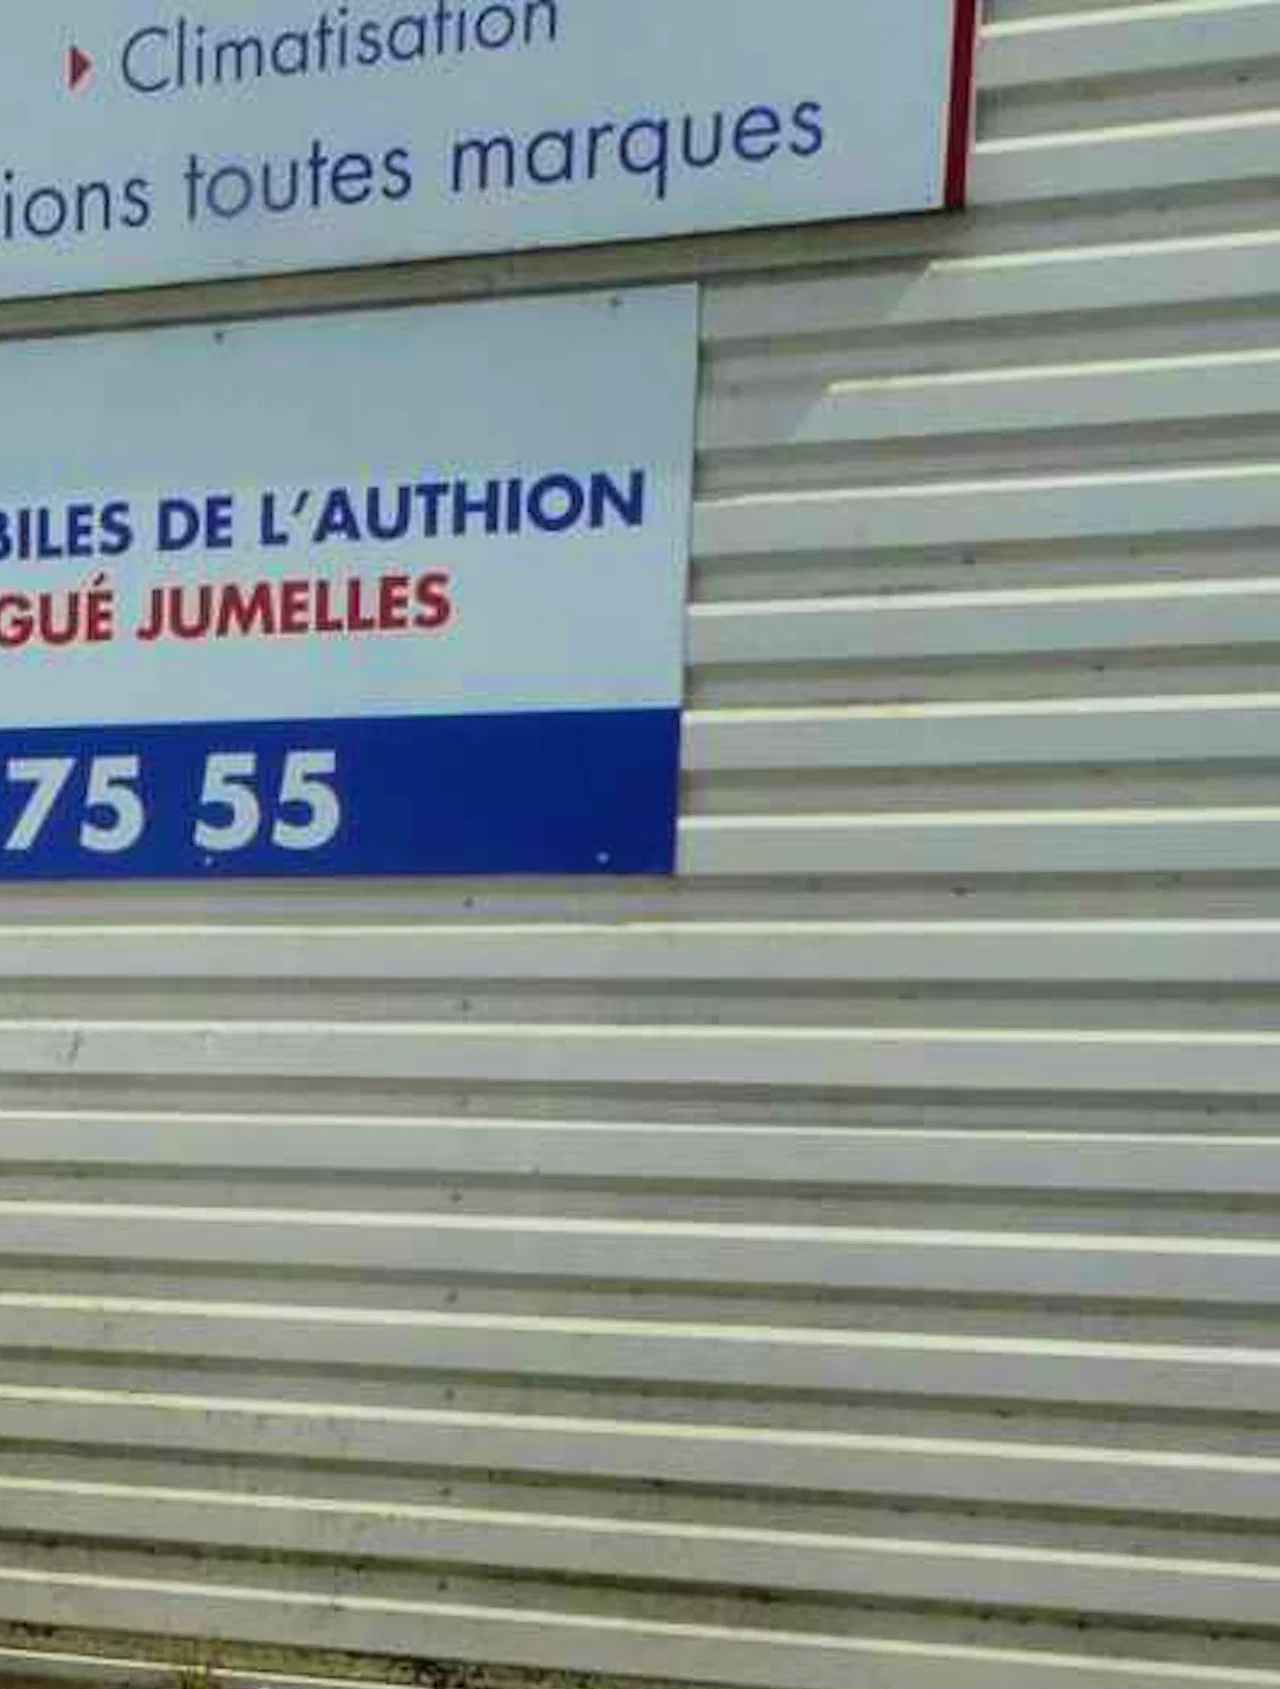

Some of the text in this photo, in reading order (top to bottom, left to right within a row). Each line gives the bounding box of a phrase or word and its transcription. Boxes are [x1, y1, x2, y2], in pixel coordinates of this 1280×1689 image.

[121, 0, 558, 94] Climatisation
[185, 141, 412, 220] toutes
[451, 97, 825, 198] marques
[156, 496, 233, 551] DE
[259, 469, 646, 546] L'AUTHION
[137, 573, 451, 641] JUMELLES
[4, 752, 144, 852] 75
[195, 750, 341, 851] 55
